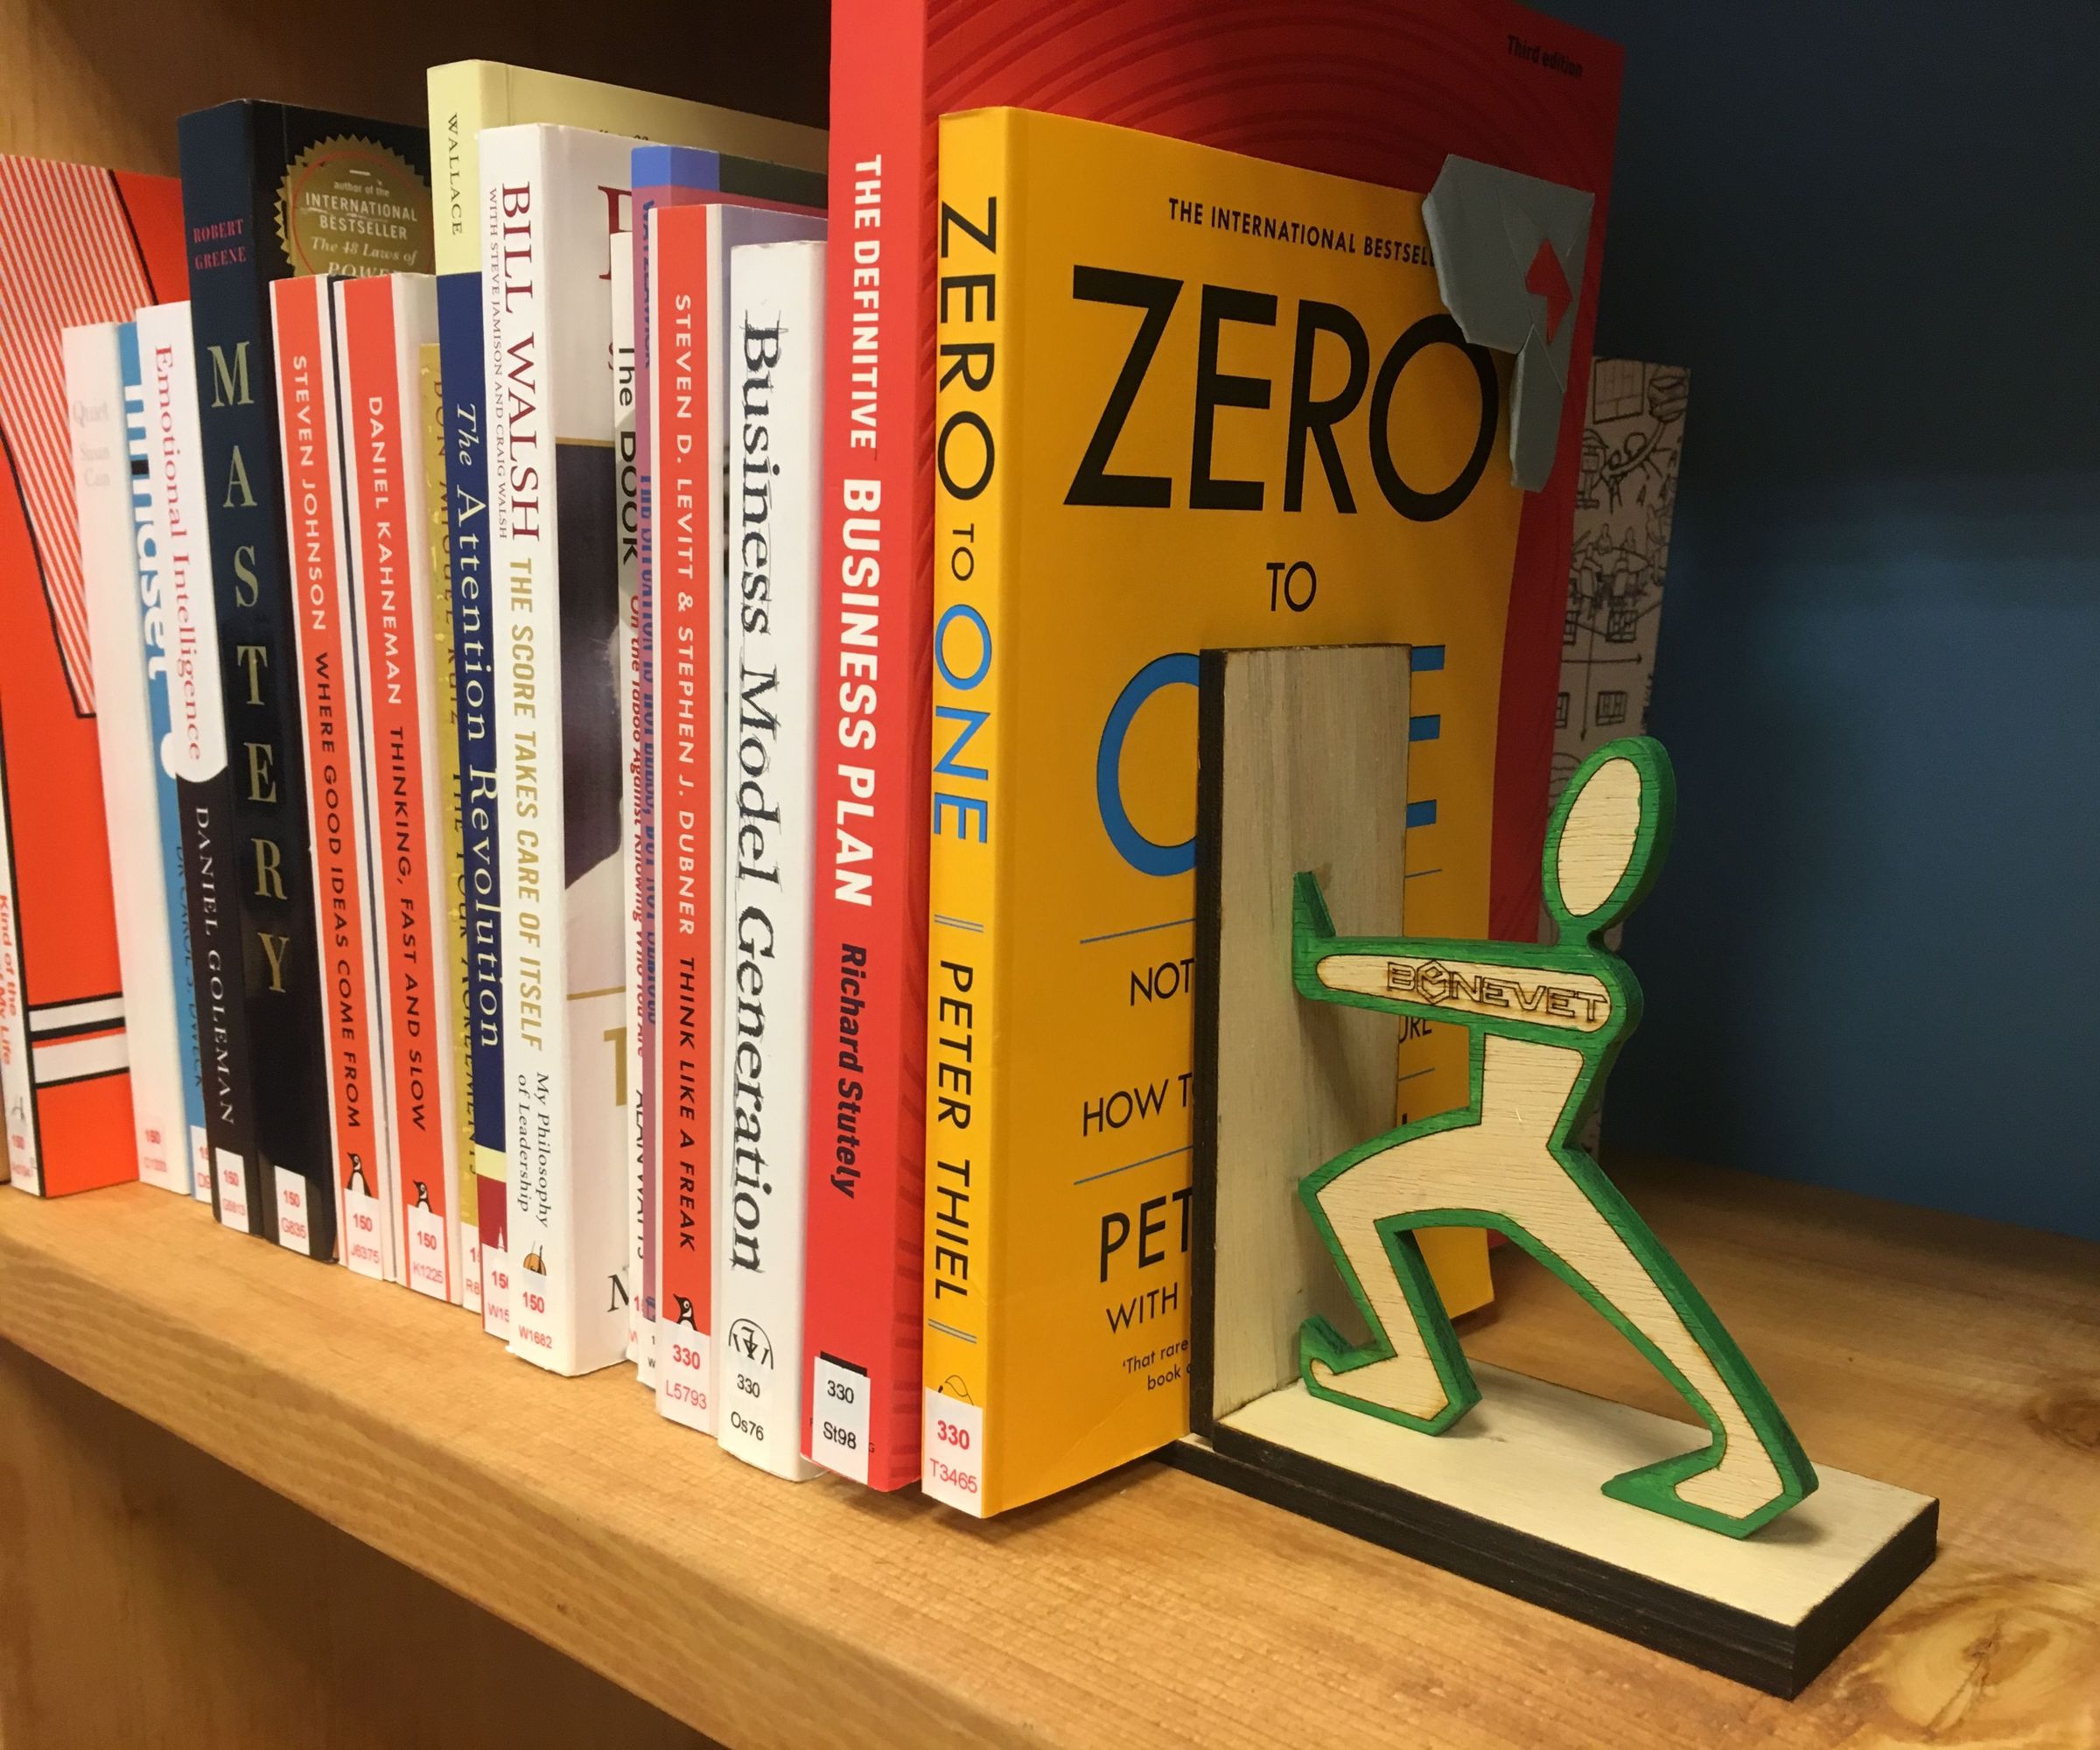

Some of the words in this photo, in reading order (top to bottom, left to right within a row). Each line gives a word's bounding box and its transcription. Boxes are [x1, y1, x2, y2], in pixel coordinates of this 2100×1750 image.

[1507, 33, 1540, 63] Third
[1542, 50, 1583, 79] edition
[334, 180, 362, 193] author
[365, 185, 374, 195] of
[375, 186, 389, 198] the
[447, 112, 463, 235] WALLACE
[855, 153, 881, 229] THE
[192, 219, 244, 243] ROBERT
[305, 192, 418, 222] INTERNATIONAL
[319, 214, 408, 241] BESTSELLER
[489, 187, 499, 236] WITH
[1168, 197, 1204, 226] THE
[1210, 206, 1356, 254] INTERNATIONAL
[194, 246, 247, 270] GREENE
[311, 236, 338, 254] The
[342, 240, 358, 256] 48
[363, 242, 399, 262] Laws
[403, 249, 419, 266] of
[490, 242, 501, 296] STEVE
[501, 181, 533, 315] BILL
[490, 300, 503, 375] JAMISON
[676, 294, 692, 419] STEVEN
[850, 240, 880, 449] DEFINITIVE
[936, 195, 998, 501] ZERO
[293, 355, 315, 466] STEVEN
[494, 382, 505, 419] AND
[1062, 264, 1500, 522] ZERO
[368, 396, 389, 509] DANIEL
[456, 402, 480, 467] The
[495, 424, 507, 478] CRAIG
[506, 332, 541, 542] WALSH
[676, 434, 692, 465] D.
[740, 315, 783, 637] Business
[497, 481, 508, 540] WALSH
[677, 479, 694, 580] LEVITT
[155, 346, 187, 538] Emotional
[172, 555, 200, 760] Intelligence
[302, 479, 326, 632] JOHNSON
[509, 557, 533, 613] THE
[951, 522, 974, 582] TO
[376, 522, 402, 705] KAHNEMAN
[457, 484, 492, 741] Attention
[678, 592, 694, 612] &
[837, 478, 881, 750] BUSINESS
[1266, 560, 1318, 612] TO
[206, 340, 292, 994] MASTERY
[511, 624, 536, 719] SCORE
[678, 626, 694, 764] STEPHEN
[314, 652, 336, 754] WHERE
[933, 603, 992, 844] ONE
[389, 726, 412, 886] THINKING,
[514, 730, 539, 820] TAKES
[678, 774, 694, 797] J.
[736, 665, 781, 886] Model
[323, 765, 343, 855] GOOD
[835, 763, 875, 907] PLAN
[516, 829, 541, 903] CARE
[679, 810, 695, 935] DUBNER
[0, 894, 12, 947] Kind
[330, 866, 349, 948] IDEAS
[399, 897, 417, 964] FAST
[468, 763, 503, 1047] Revolution
[518, 910, 542, 948] OF
[4, 953, 14, 976] of
[196, 806, 218, 935] DANIEL
[207, 948, 234, 1124] GOLEMAN
[7, 981, 18, 1017] the
[336, 959, 356, 1041] COME
[404, 973, 421, 1039] AND
[519, 956, 543, 1052] ITSELF
[680, 956, 695, 1050] THINK
[837, 942, 866, 1074] Richard
[937, 959, 975, 1129] PETER
[342, 1051, 361, 1129] FROM
[409, 1049, 427, 1133] SLOW
[517, 1074, 530, 1099] of
[535, 1071, 551, 1107] My
[680, 1059, 695, 1122] LIKE
[731, 906, 775, 1273] Generation
[1083, 1078, 1170, 1138] HOW
[516, 1102, 533, 1213] Leadership
[536, 1111, 552, 1229] Philosophy
[680, 1129, 695, 1149] A
[830, 1077, 863, 1199] Stutely
[284, 1189, 301, 1208] 150
[353, 1212, 374, 1233] 150
[680, 1160, 696, 1252] FREAK
[934, 1158, 971, 1300] THIEL
[413, 1261, 444, 1284] K1225
[417, 1229, 438, 1251] 150
[522, 1291, 545, 1314] 150
[1106, 1282, 1179, 1334] WITH
[519, 1324, 553, 1350] W1682
[672, 1343, 702, 1370] 330
[1160, 1339, 1189, 1361] rare
[665, 1379, 708, 1410] L5793
[737, 1374, 761, 1399] 330
[827, 1379, 855, 1404] 330
[1147, 1363, 1181, 1391] book
[730, 1410, 765, 1442] Os76
[822, 1420, 858, 1451] St98
[936, 1419, 970, 1451] 330
[929, 1457, 979, 1494] T3465
